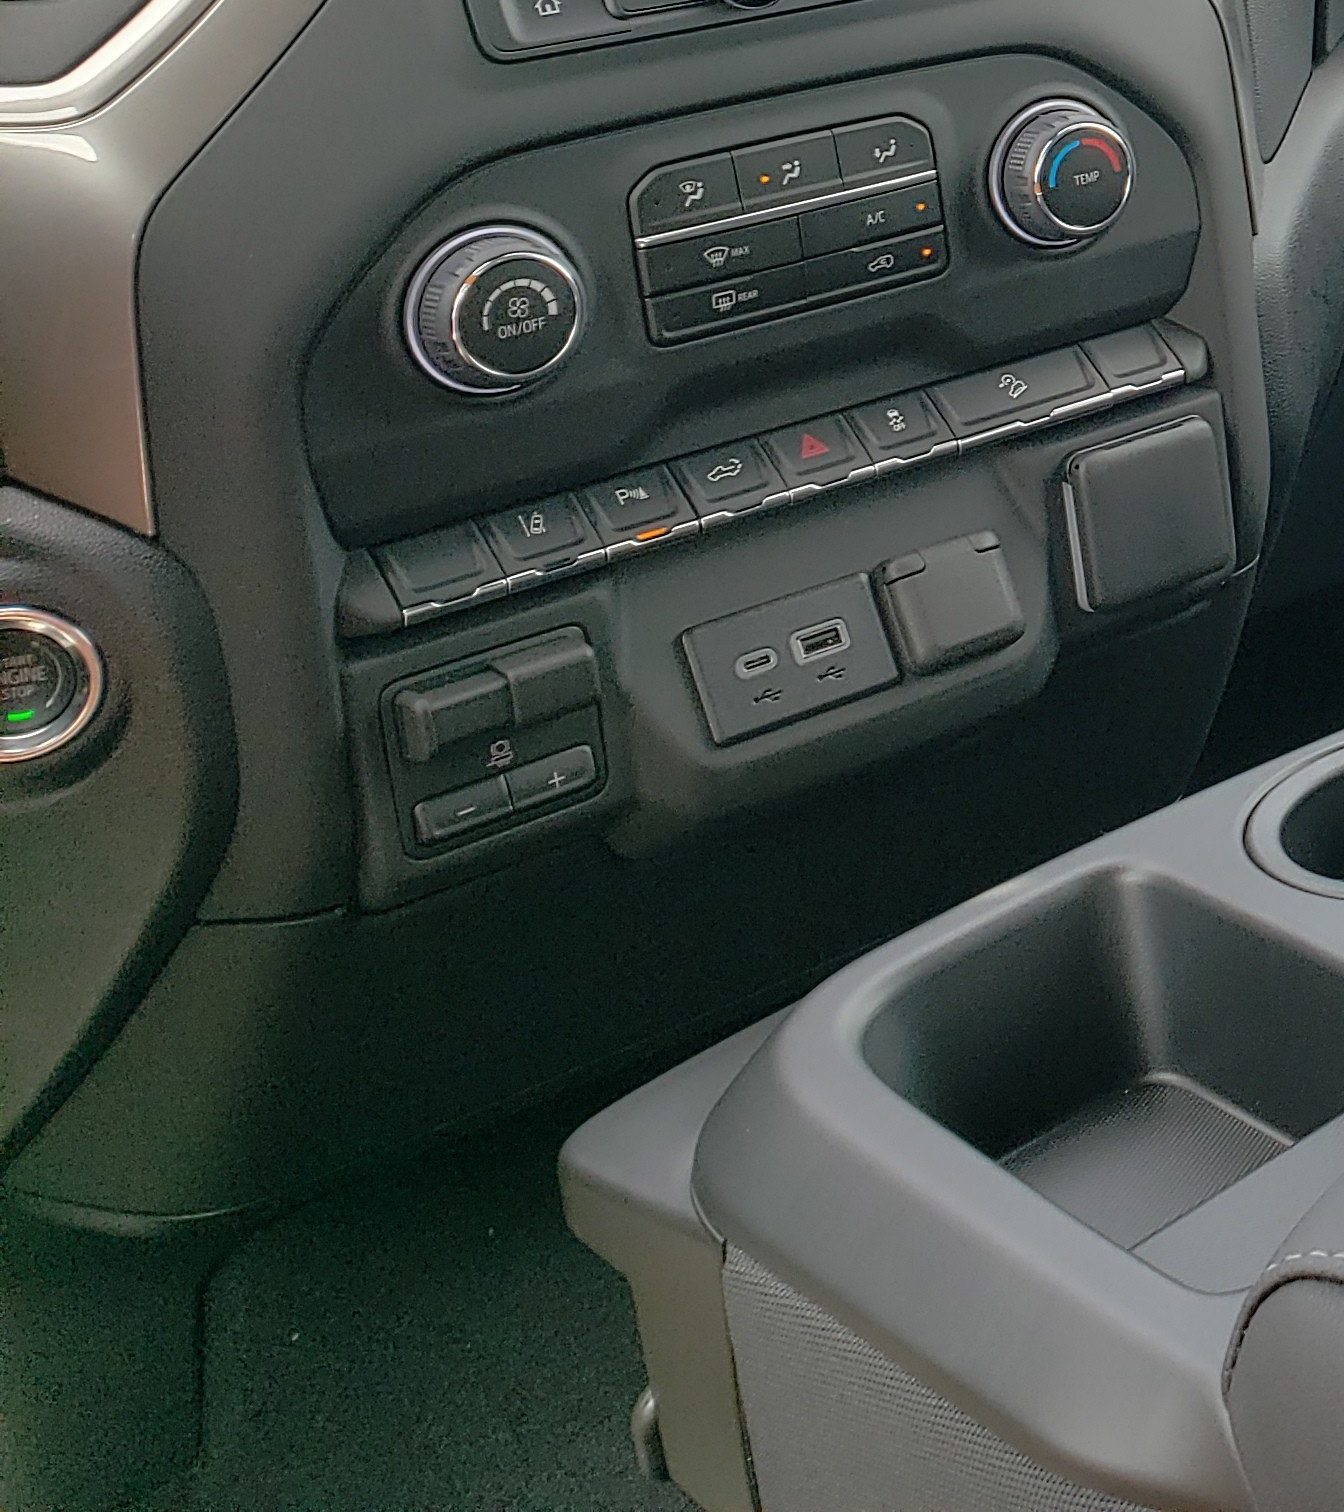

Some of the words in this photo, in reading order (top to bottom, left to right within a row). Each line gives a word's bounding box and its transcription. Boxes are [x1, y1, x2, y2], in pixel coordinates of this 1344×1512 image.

[1073, 170, 1100, 186] TEMP
[866, 210, 886, 226] A/C
[730, 245, 750, 257] MAX
[737, 289, 759, 303] REAR
[498, 316, 547, 339] ON/OFF
[0, 665, 48, 686] NGINE
